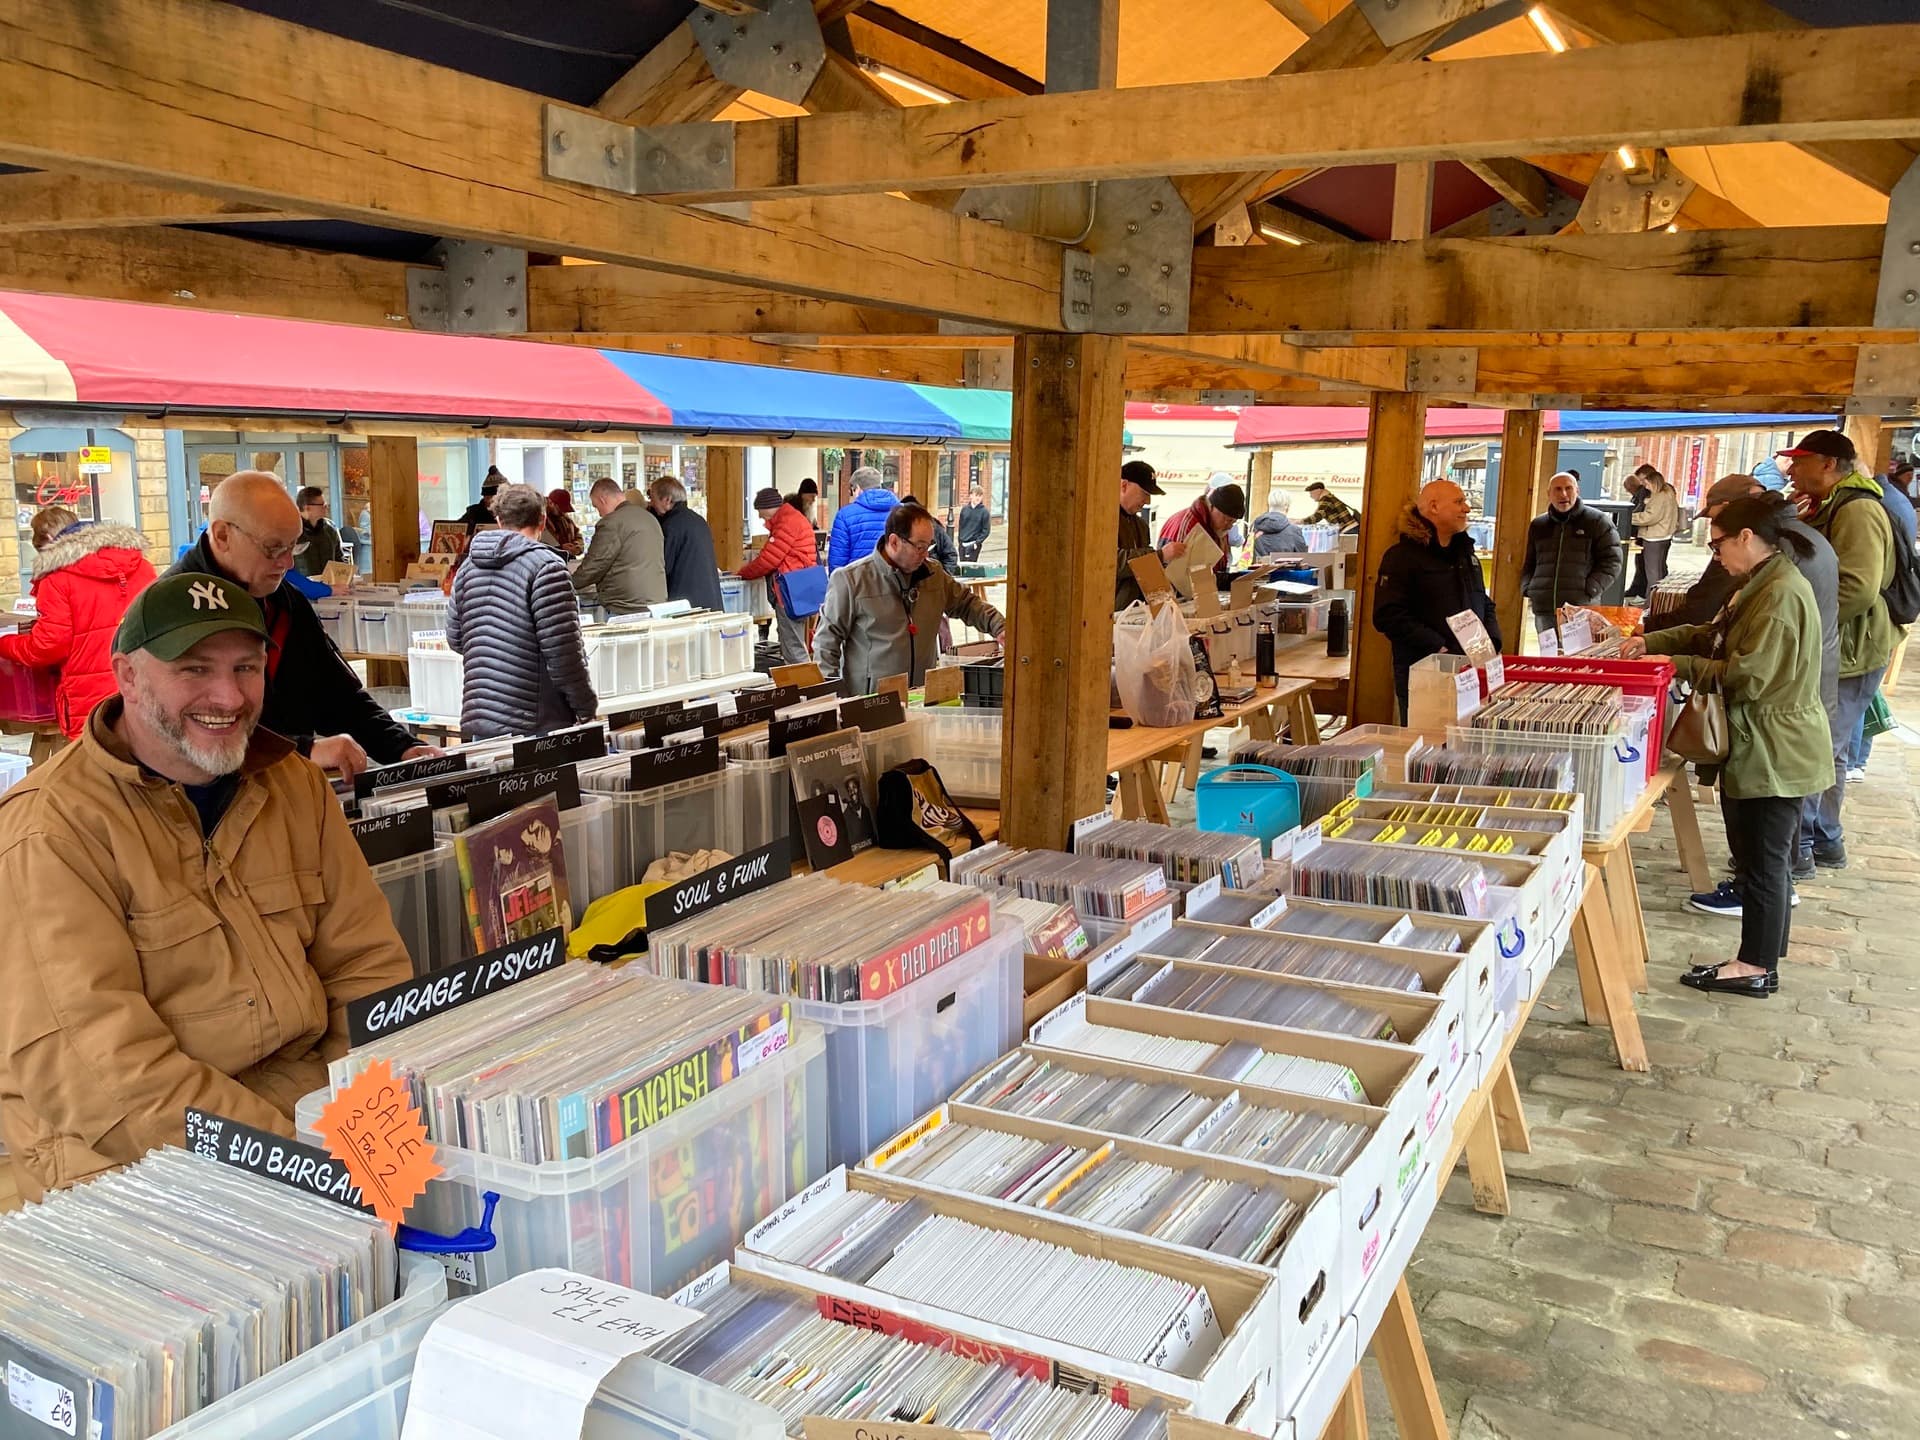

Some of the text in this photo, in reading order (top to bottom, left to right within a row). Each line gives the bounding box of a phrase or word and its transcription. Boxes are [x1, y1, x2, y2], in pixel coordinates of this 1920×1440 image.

[1272, 474, 1309, 482] atoes
[1330, 475, 1361, 484] Roast
[535, 733, 586, 754] MISC Q-T
[797, 751, 813, 765] FUN
[814, 749, 829, 762] BOY
[654, 750, 675, 766] MISC
[375, 768, 405, 787] ROCK
[499, 776, 529, 796] PROG
[533, 770, 560, 786] ROCK
[672, 852, 772, 915] SOUL & FUNK
[901, 925, 961, 985] PIED PIPER
[365, 970, 467, 1033] GARAGE
[485, 938, 558, 988] PSYCH
[186, 1110, 223, 1134] OR ANY
[186, 1124, 219, 1145] 3 FOR
[366, 1085, 422, 1165] SALE
[228, 1132, 263, 1167] £10
[345, 1108, 364, 1131] 3
[377, 1163, 397, 1188] 2
[540, 1280, 629, 1308] SALE
[551, 1303, 665, 1341] £1 EACH
